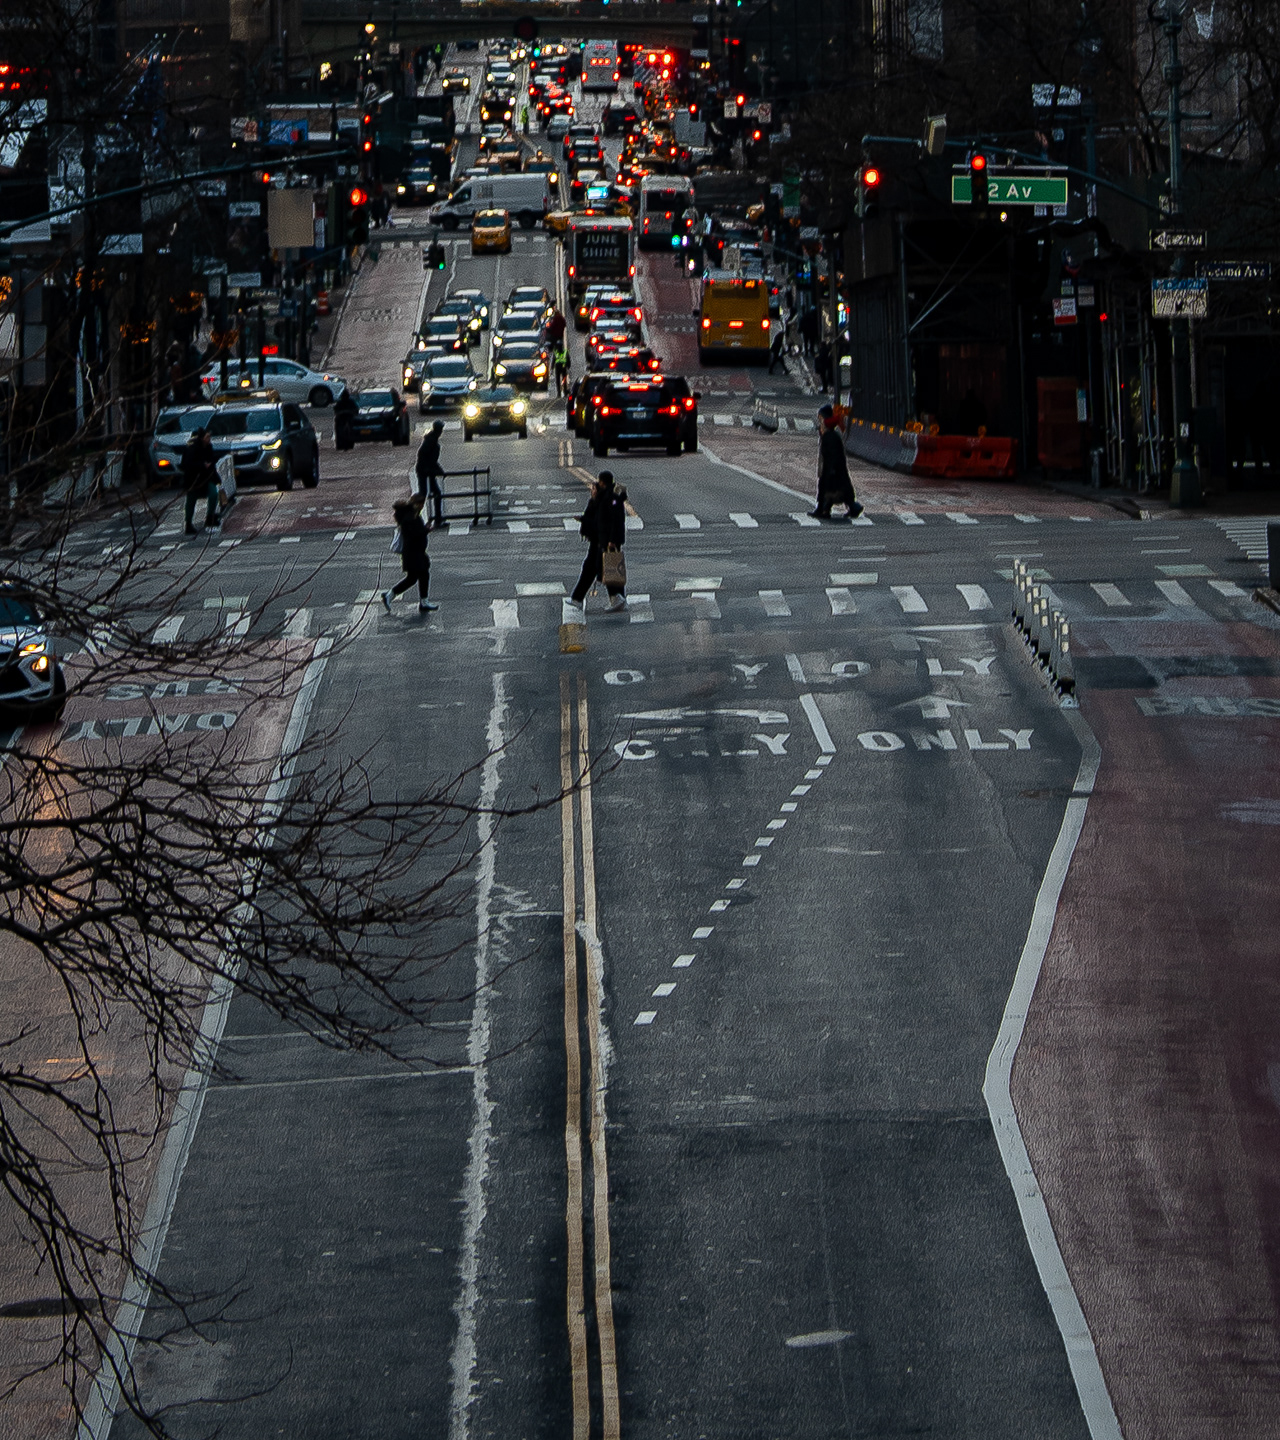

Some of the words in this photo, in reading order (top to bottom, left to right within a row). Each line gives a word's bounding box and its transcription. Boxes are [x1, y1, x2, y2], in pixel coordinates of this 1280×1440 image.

[988, 182, 999, 199] 2
[1006, 183, 1032, 199] Av
[586, 233, 618, 244] JUNE
[582, 247, 620, 258] SHINE
[830, 656, 997, 679] OLY
[857, 728, 1035, 752] ONLY
